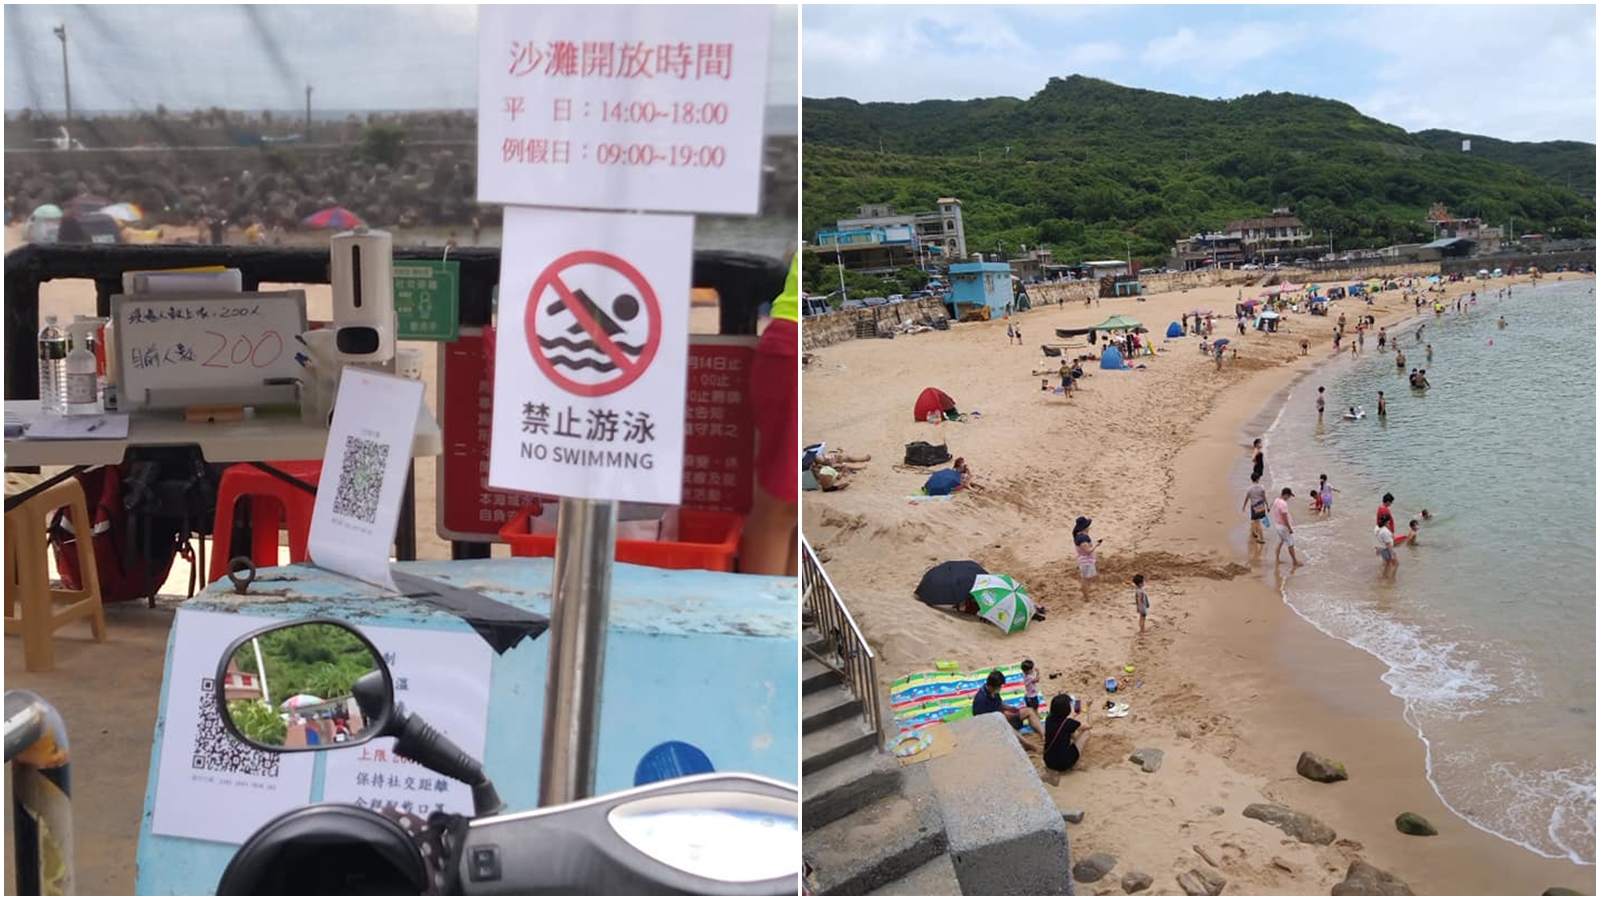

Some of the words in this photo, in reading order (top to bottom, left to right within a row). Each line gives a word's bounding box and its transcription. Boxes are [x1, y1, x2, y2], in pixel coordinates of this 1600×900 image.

[508, 40, 734, 81] 沙灘開放時間
[201, 330, 283, 369] 200
[521, 401, 655, 444] 禁止游泳
[520, 442, 548, 461] NO
[552, 446, 654, 470] SWIMMNG
[356, 771, 449, 792] 保持社交距離
